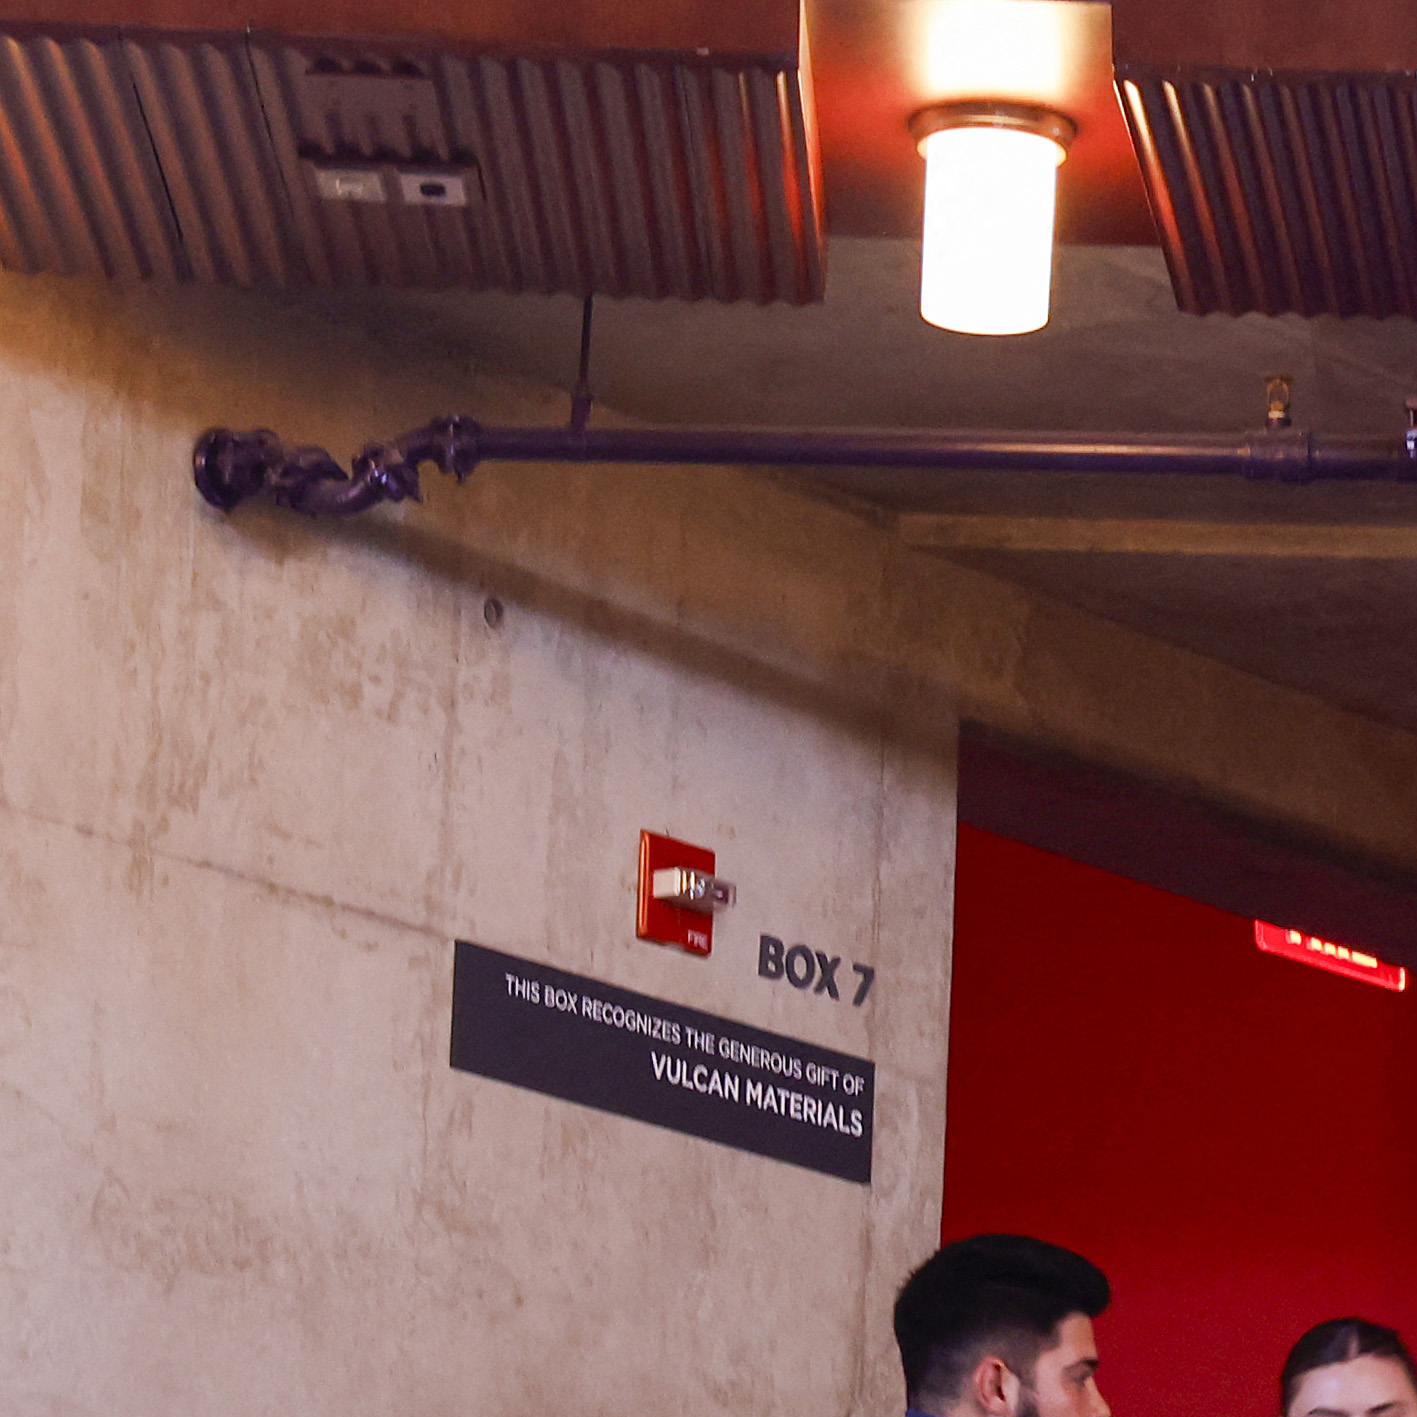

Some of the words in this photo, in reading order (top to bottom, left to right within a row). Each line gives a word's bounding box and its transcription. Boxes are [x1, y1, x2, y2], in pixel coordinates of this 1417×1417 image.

[758, 934, 842, 1002] BOX
[851, 962, 876, 1007] 7
[505, 972, 541, 1005] THIS
[544, 984, 578, 1015] BOX
[581, 995, 682, 1046] RECOGNIZES
[685, 1025, 716, 1056] THE
[718, 1036, 803, 1081] GENEROUS
[805, 1062, 840, 1092] GIFT
[843, 1072, 865, 1098] OF
[651, 1050, 740, 1104] VULCAN
[745, 1077, 864, 1138] MATERIALS
